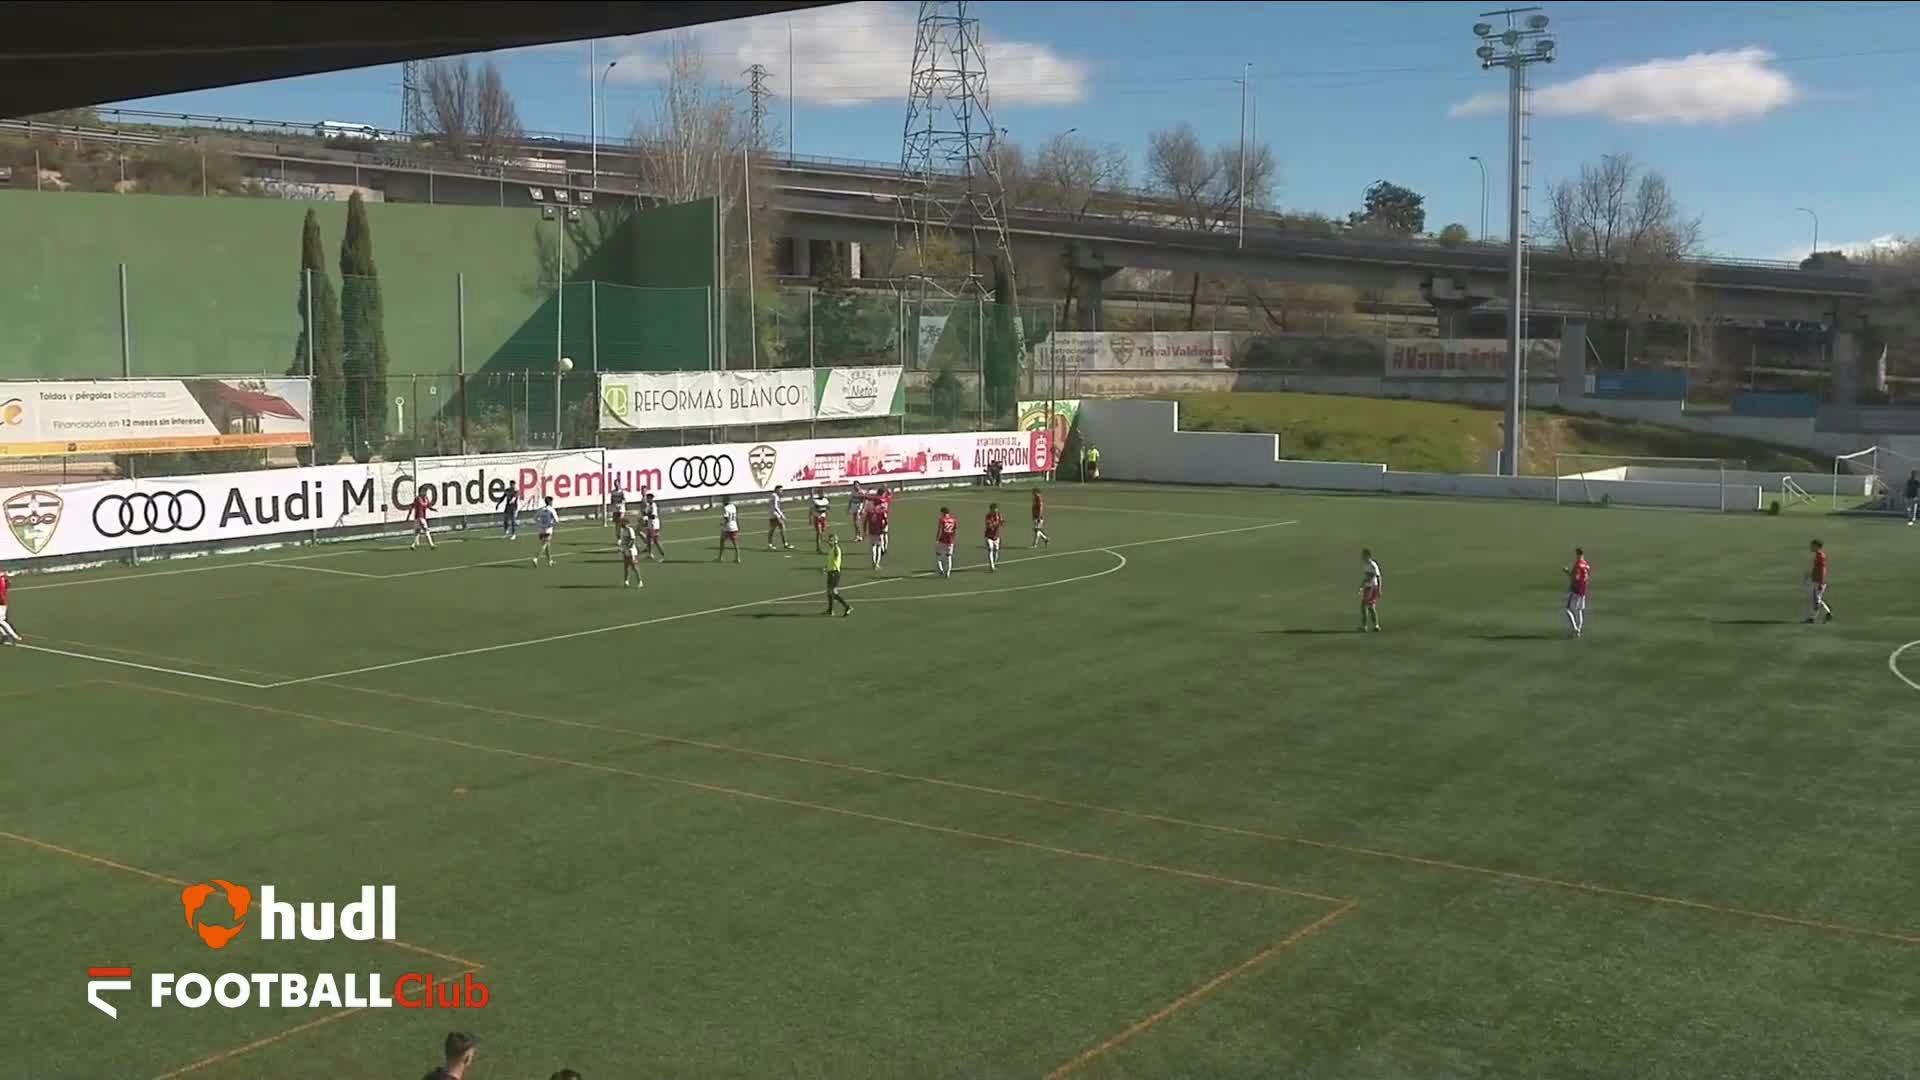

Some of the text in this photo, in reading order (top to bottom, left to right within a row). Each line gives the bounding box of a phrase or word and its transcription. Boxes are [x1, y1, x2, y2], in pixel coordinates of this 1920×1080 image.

[40, 392, 67, 400] Toldos
[75, 391, 112, 401] pérgolas
[634, 389, 722, 412] REFORMAS
[121, 419, 131, 427] 12
[133, 419, 158, 427] meses
[171, 417, 205, 426] intereses
[220, 481, 323, 528] Audi
[519, 463, 662, 500] Premium
